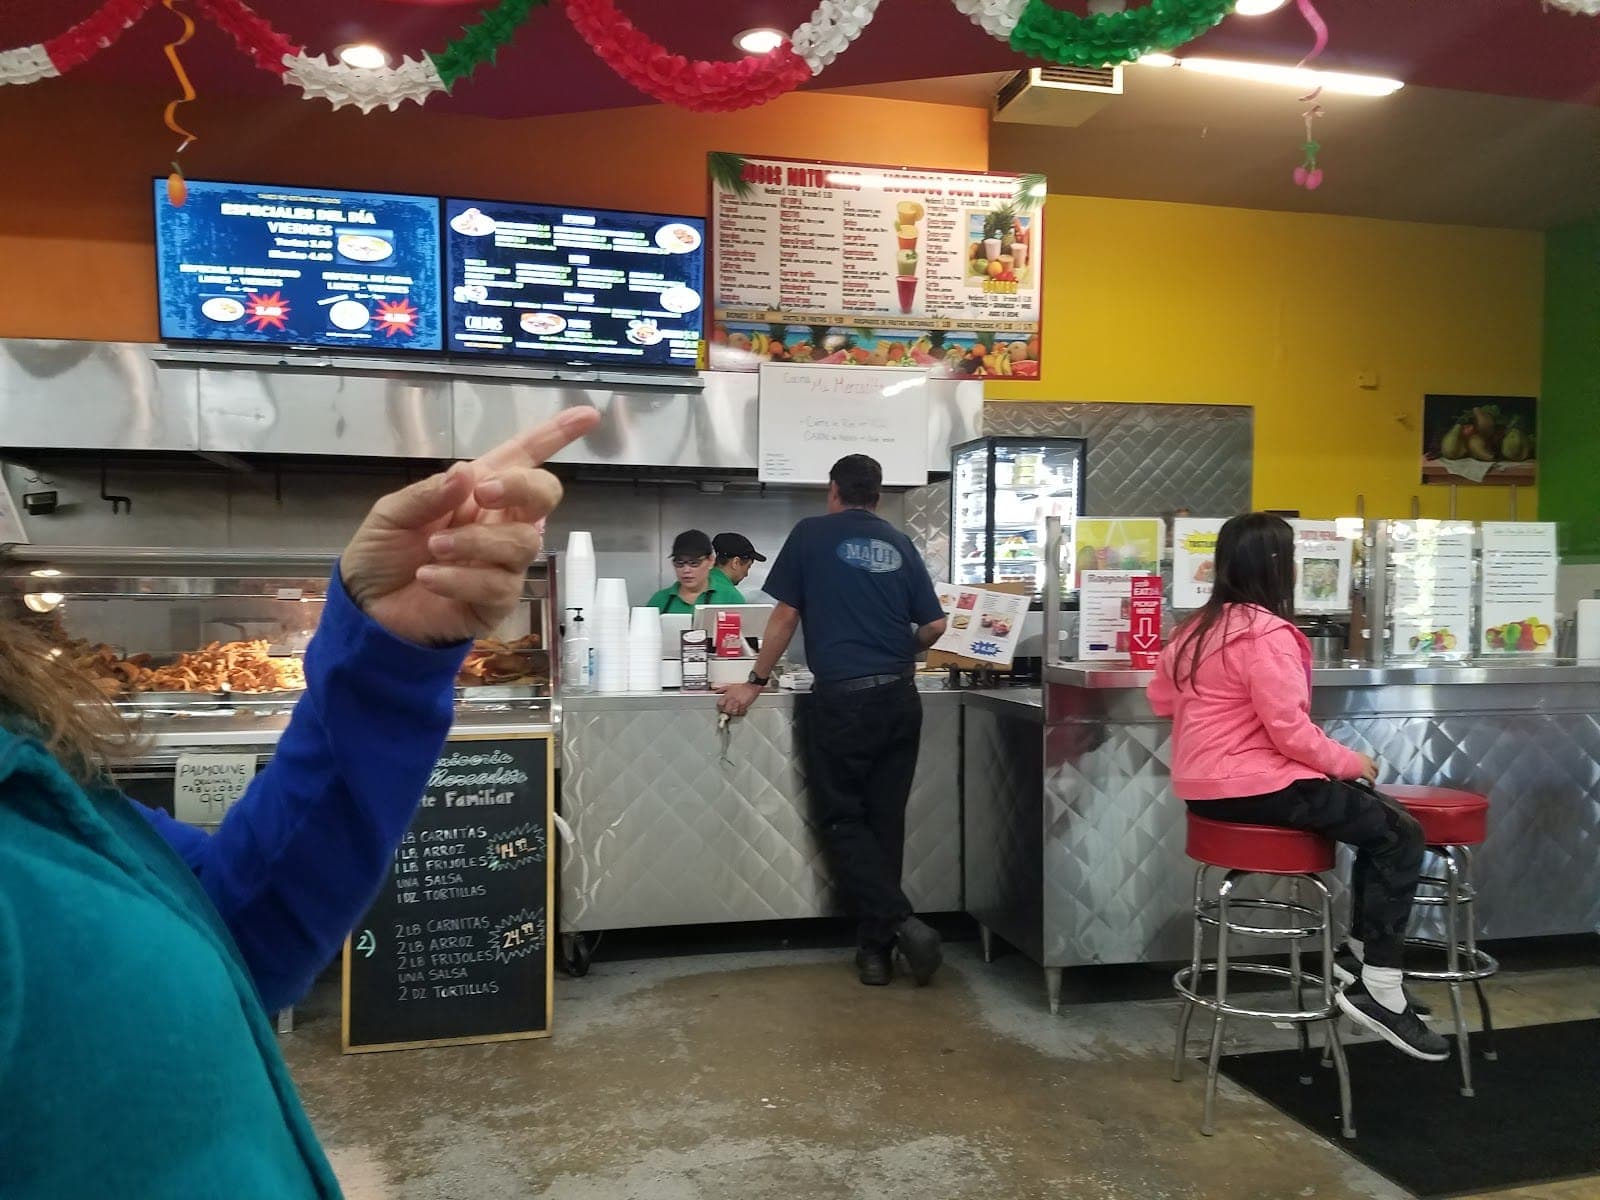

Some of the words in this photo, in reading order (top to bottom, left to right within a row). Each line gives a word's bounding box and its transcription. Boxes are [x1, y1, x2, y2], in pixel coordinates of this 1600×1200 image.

[220, 203, 315, 220] ESPECIALES
[316, 209, 347, 222] DEL
[267, 221, 333, 236] VIERNES
[445, 789, 515, 807] Familiar
[420, 827, 487, 843] CARNITAS
[423, 844, 465, 858] ARROZ
[426, 856, 488, 872] FRIJOLES
[397, 878, 420, 889] UNA
[424, 873, 463, 887] SALSA
[423, 885, 487, 901] TORTILLAS
[426, 916, 490, 933] CARNITAS
[429, 935, 474, 950] ARROZ
[431, 947, 494, 966] FRIJOLES
[398, 972, 424, 983] UNA
[428, 968, 468, 981] SALSA
[433, 981, 500, 998] TORTILLAS
